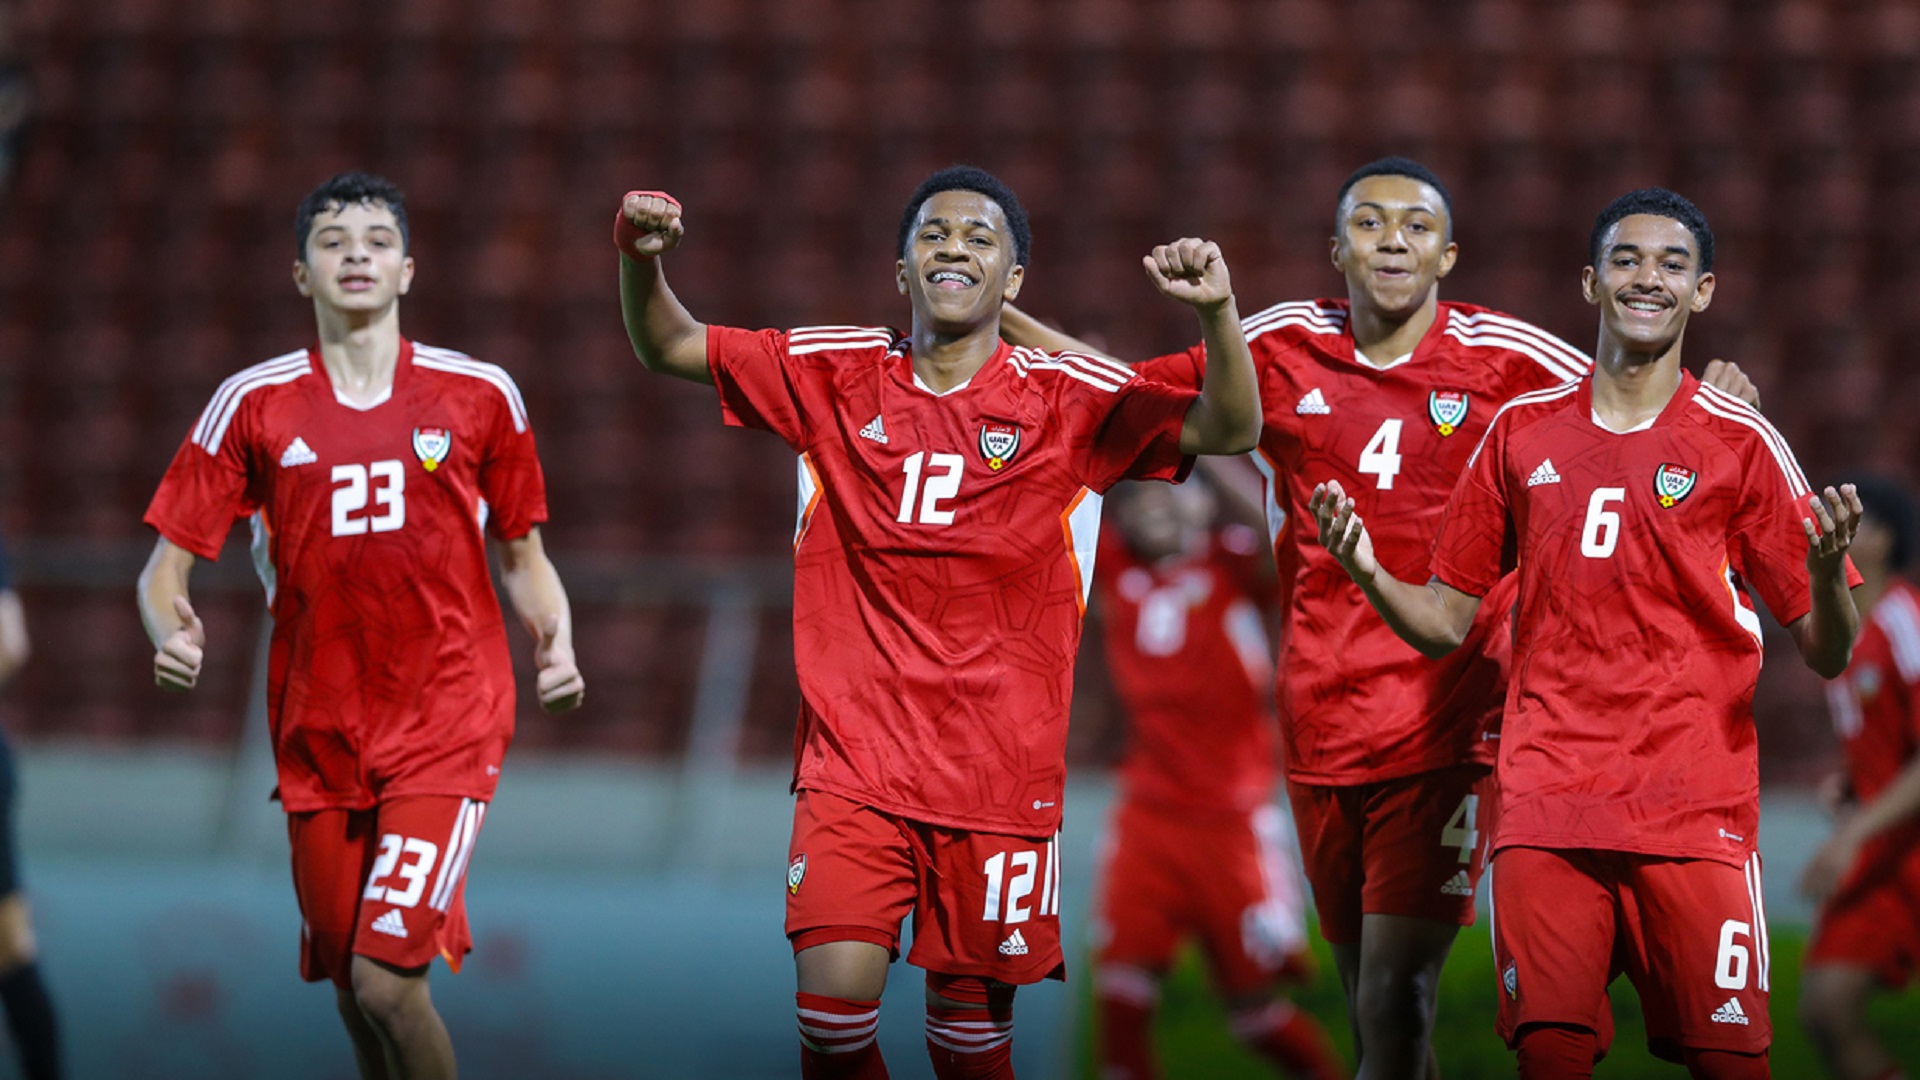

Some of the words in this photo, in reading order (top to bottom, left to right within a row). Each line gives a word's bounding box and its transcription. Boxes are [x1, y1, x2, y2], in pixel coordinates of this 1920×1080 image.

[859, 428, 888, 444] adidas
[989, 436, 1010, 445] UAE
[1358, 418, 1403, 489] 4
[331, 459, 405, 537] 23
[896, 451, 965, 525] 12
[1527, 473, 1561, 487] adidas
[1666, 475, 1685, 486] UAE
[1580, 487, 1625, 558] 6
[1440, 794, 1480, 863] 4
[363, 833, 438, 908] 23
[982, 850, 1038, 924] 12
[998, 945, 1028, 955] adidas
[1714, 919, 1750, 990] 6
[1711, 1012, 1749, 1025] adidas
